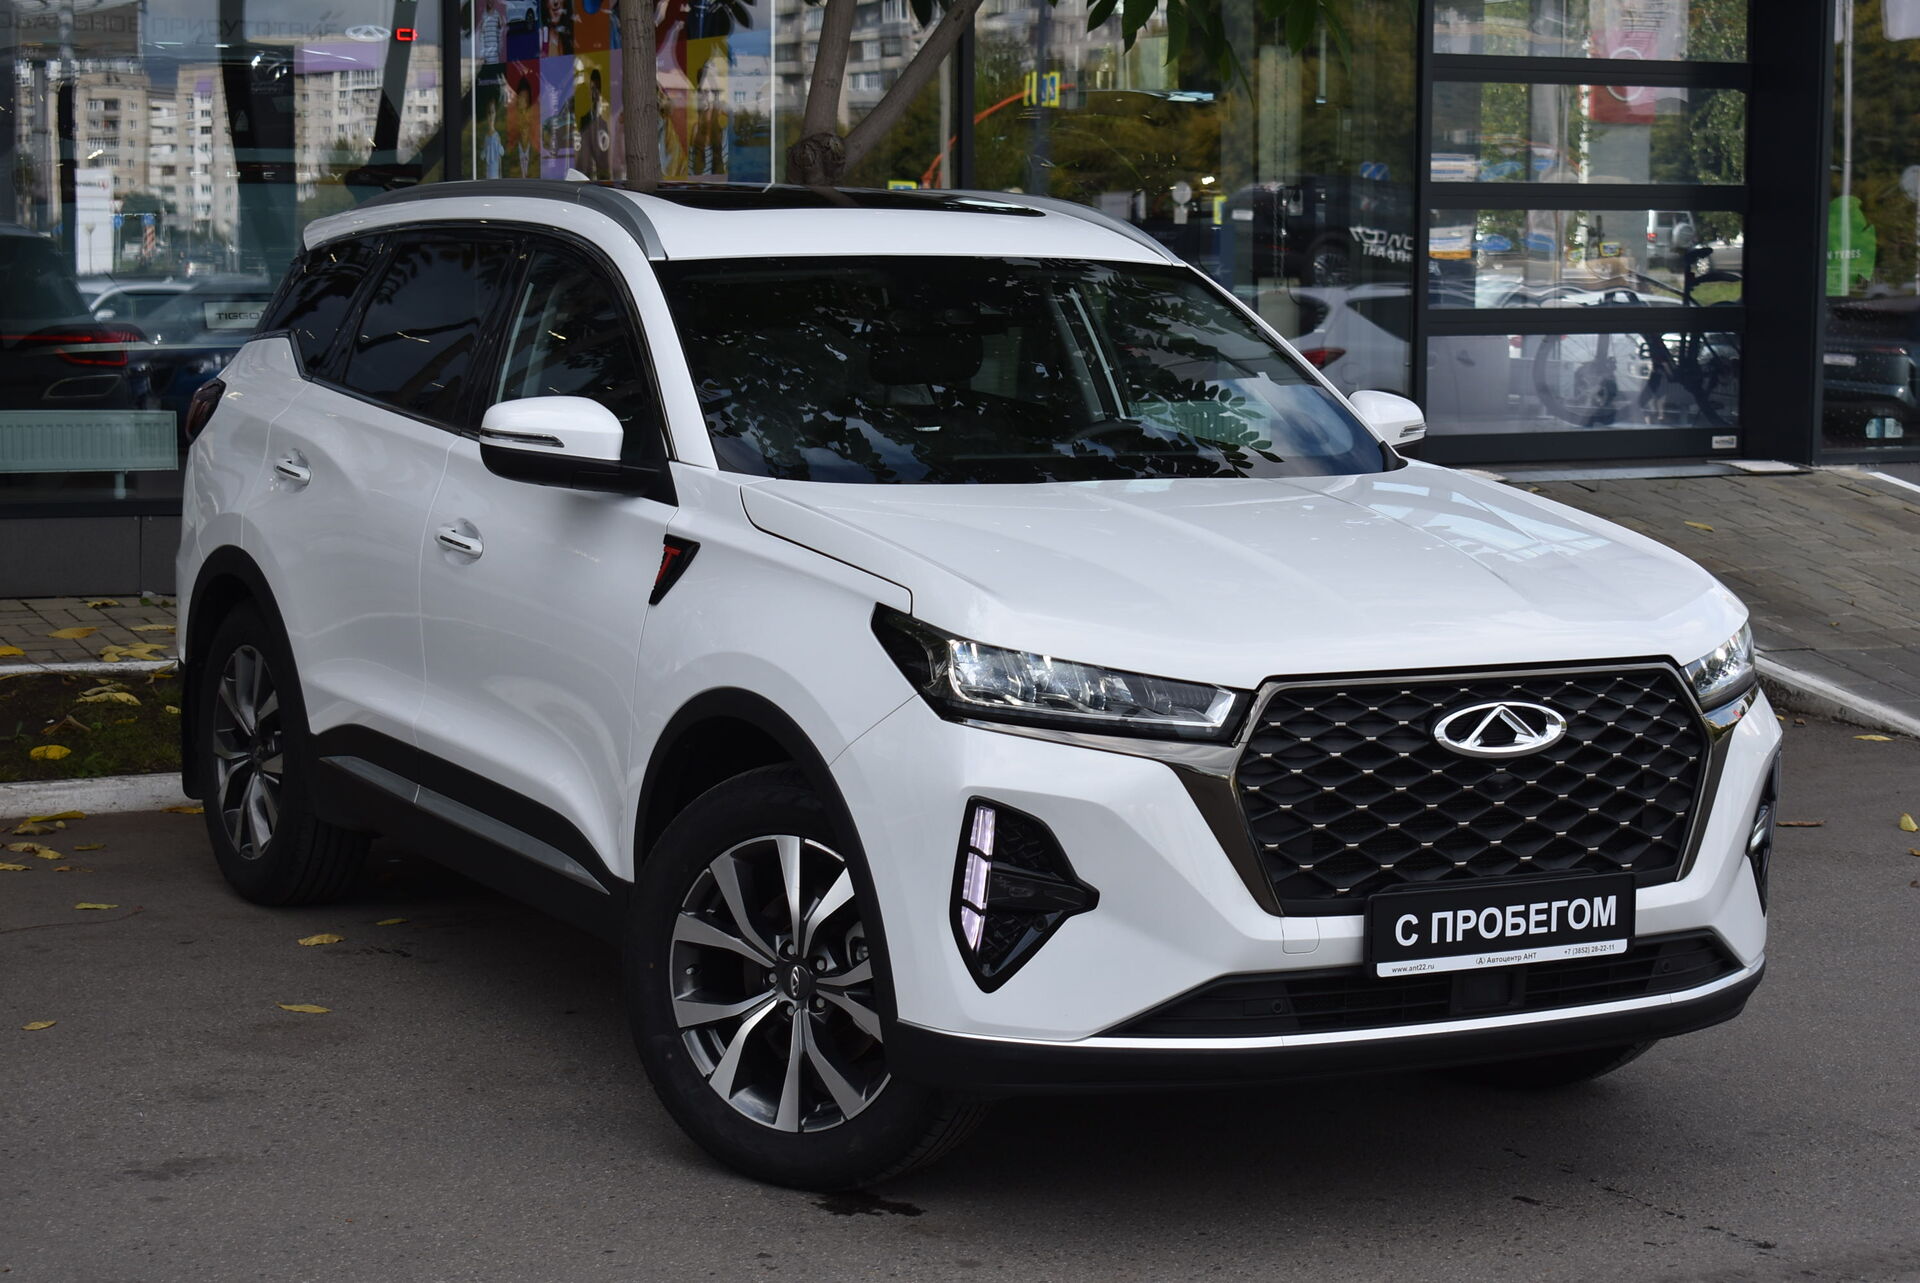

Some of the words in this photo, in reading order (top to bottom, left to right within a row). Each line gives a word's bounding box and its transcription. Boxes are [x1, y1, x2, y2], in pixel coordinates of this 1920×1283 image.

[1395, 914, 1418, 947] С
[1430, 895, 1617, 944] ПРОБЕГОМ
[1486, 954, 1522, 964] Автоцентр
[1523, 952, 1537, 961] АНТ
[1391, 963, 1435, 973] www.ant22.ru
